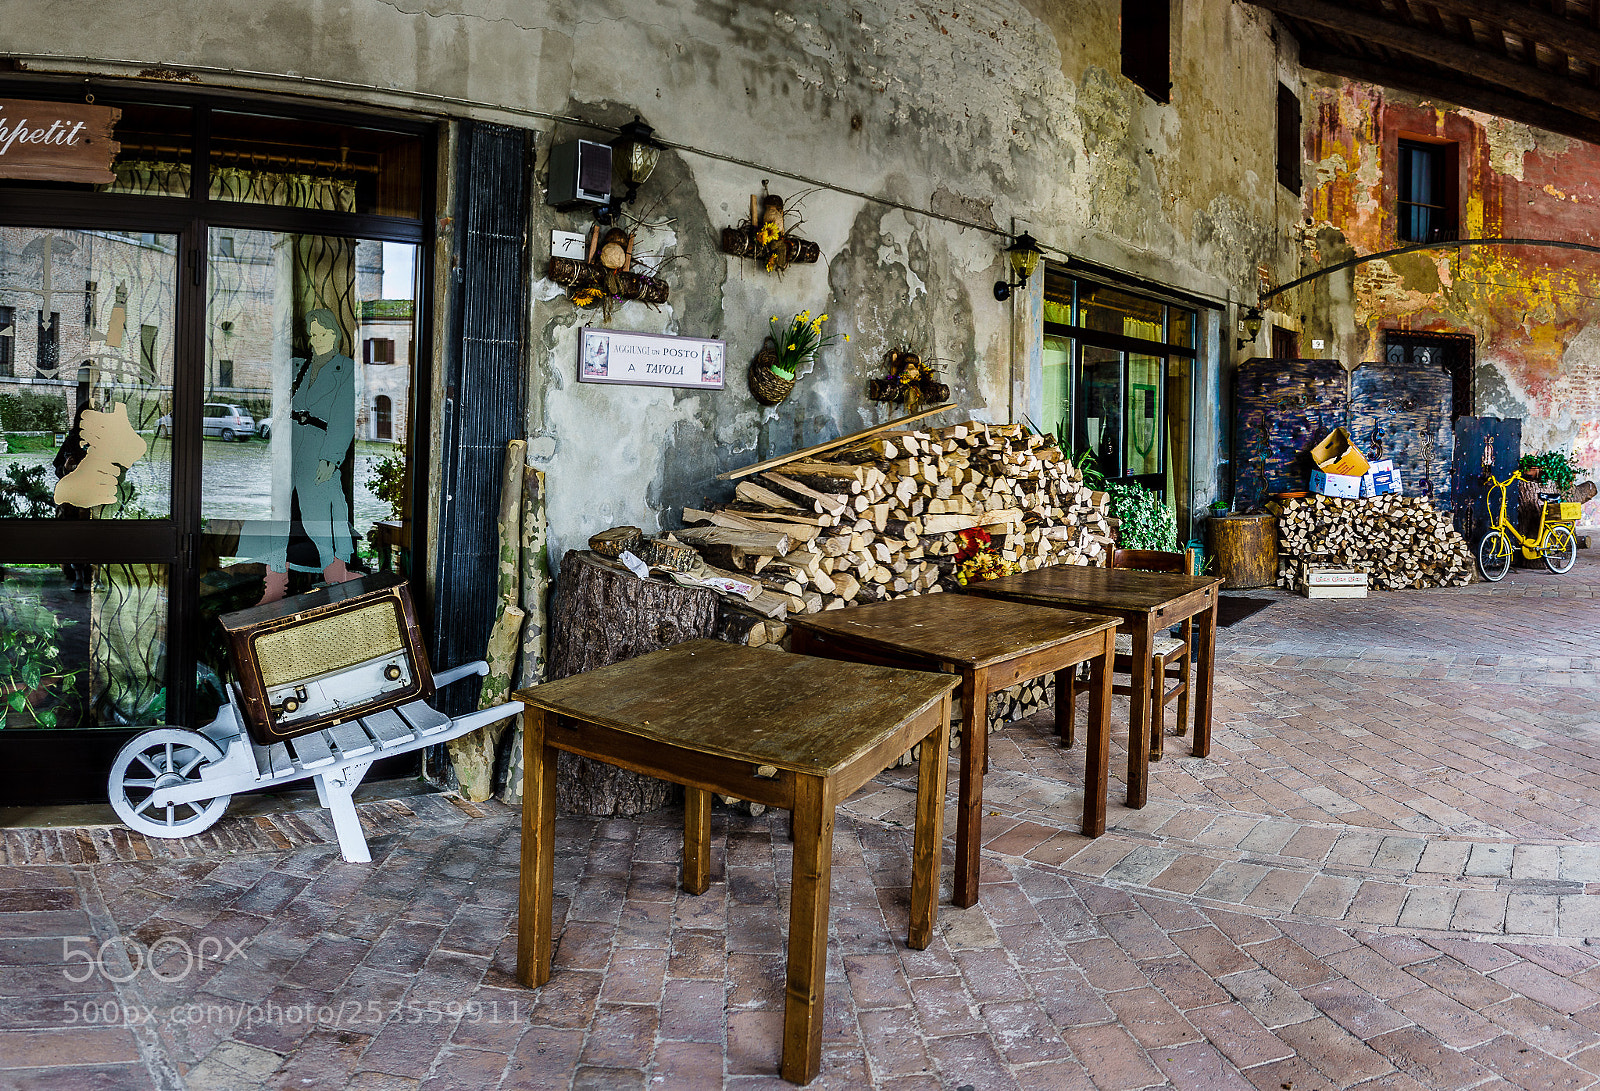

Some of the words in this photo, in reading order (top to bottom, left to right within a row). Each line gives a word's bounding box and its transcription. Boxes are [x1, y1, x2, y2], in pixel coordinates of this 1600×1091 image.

[613, 344, 650, 355] AGGIUNGI
[662, 347, 699, 358] POSTO
[627, 363, 635, 371] A
[646, 363, 684, 375] TAVOLA
